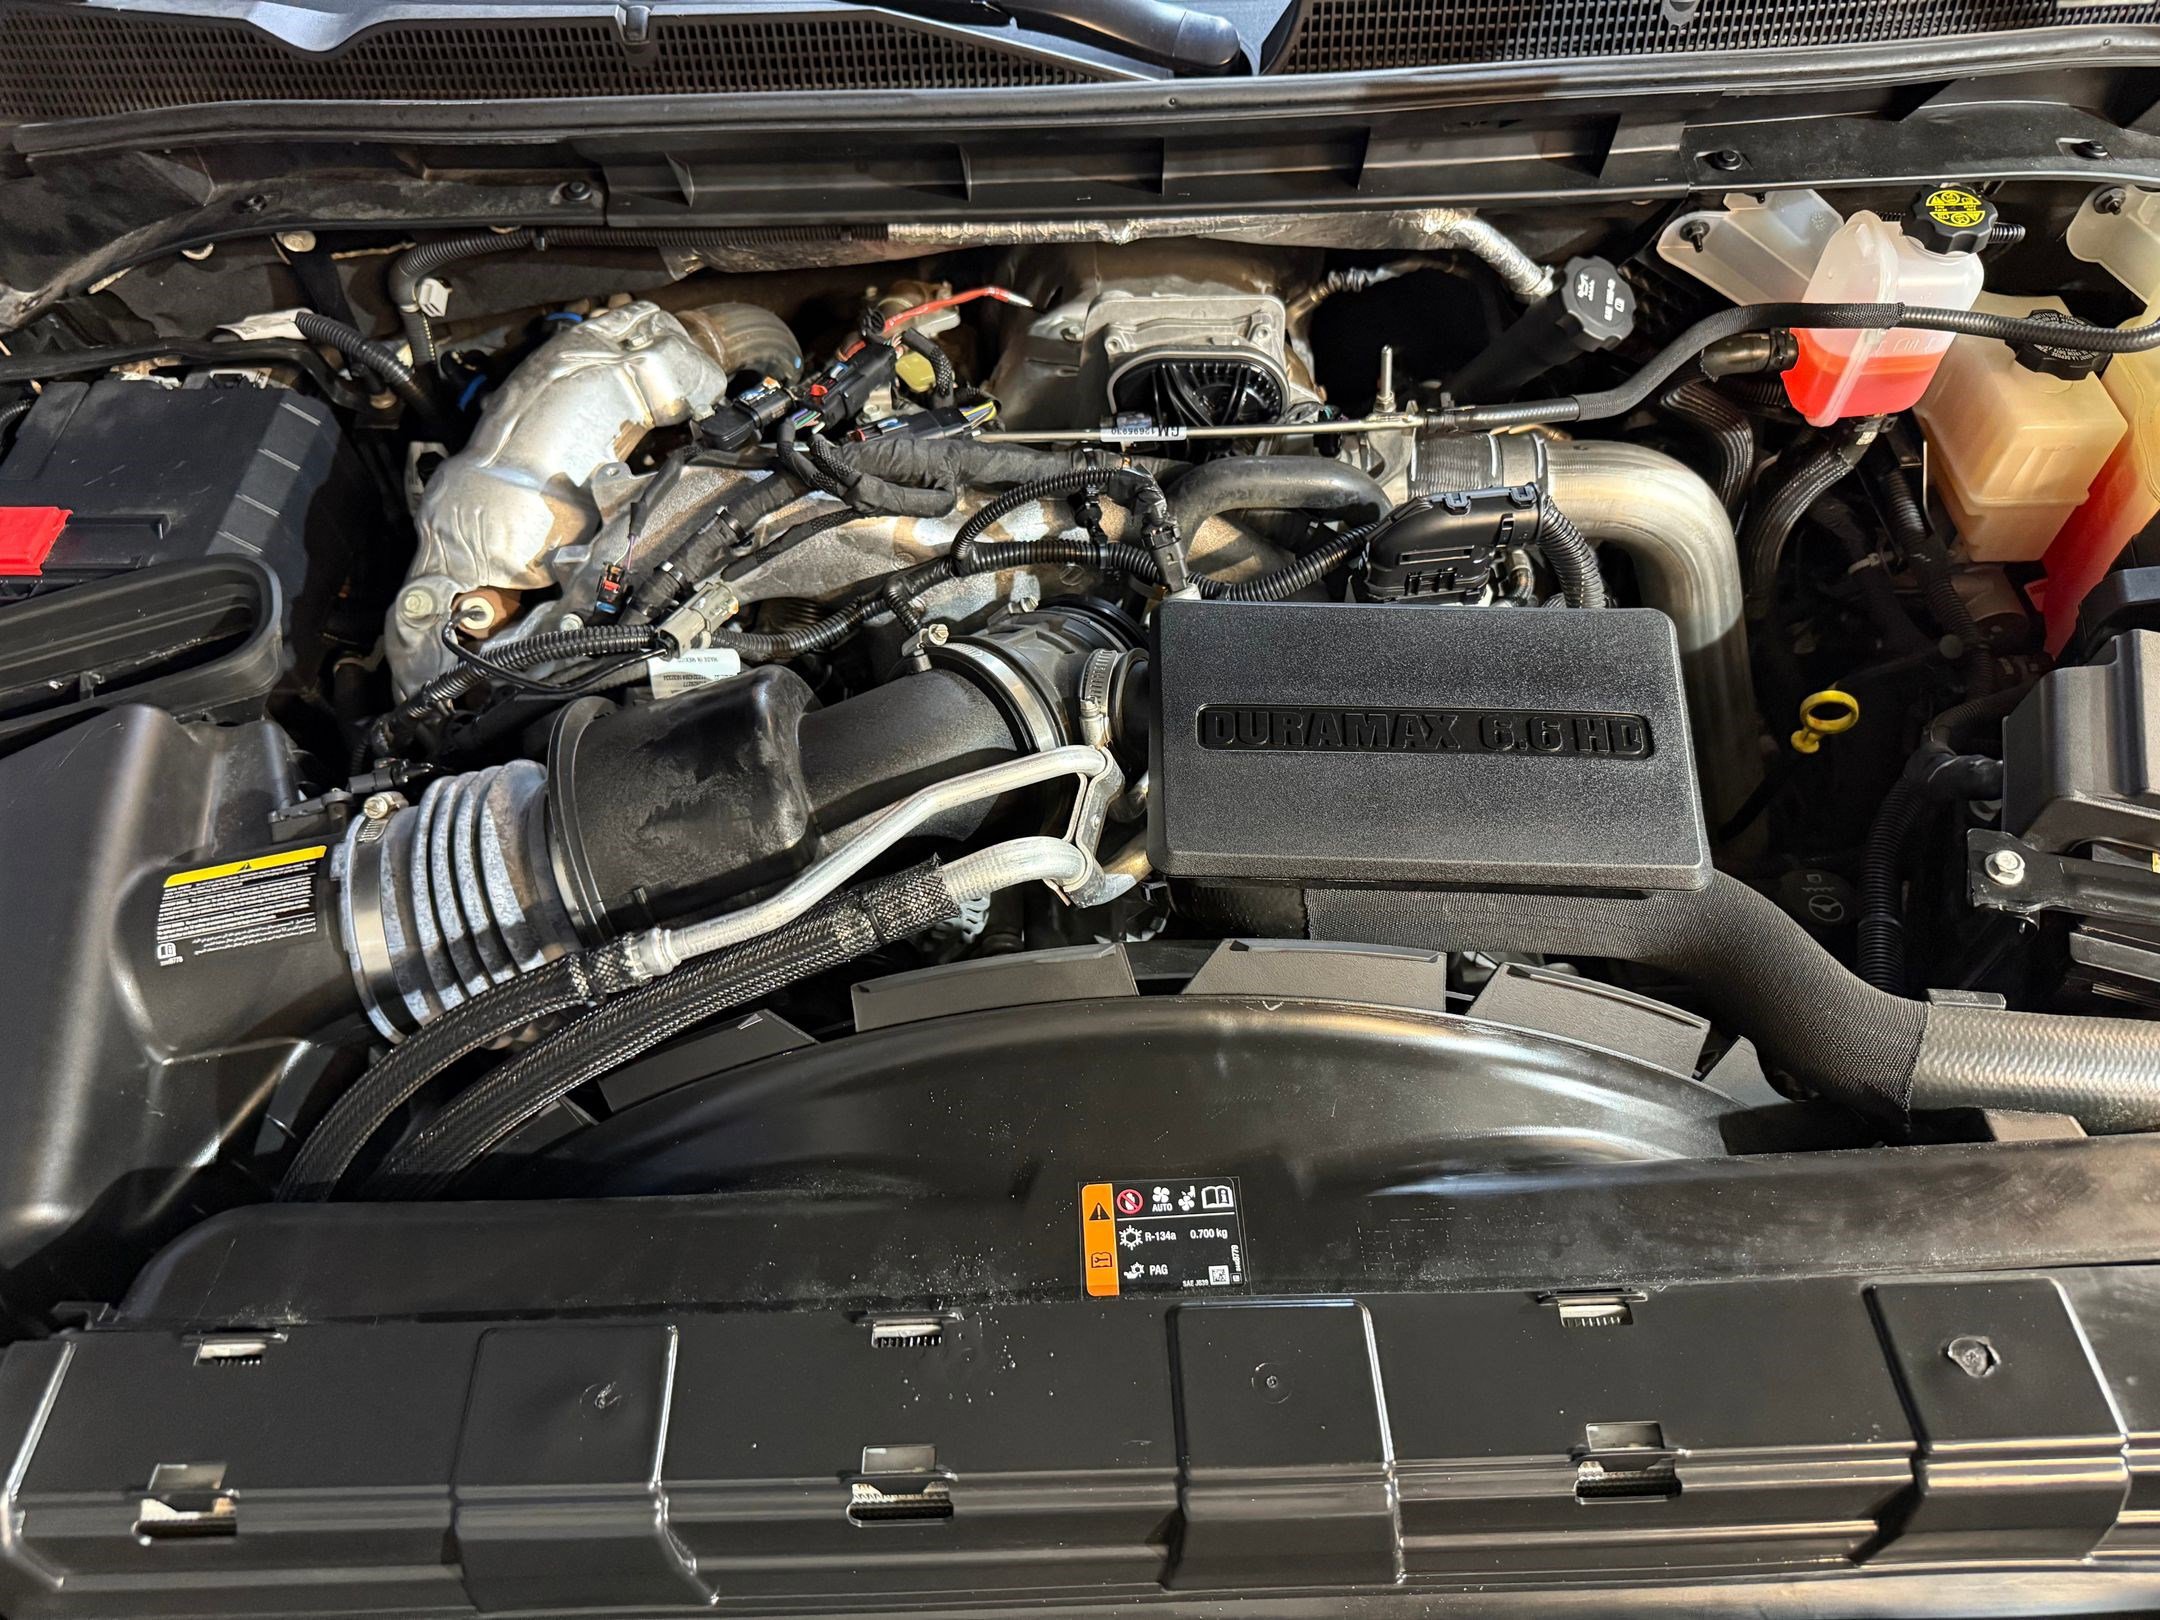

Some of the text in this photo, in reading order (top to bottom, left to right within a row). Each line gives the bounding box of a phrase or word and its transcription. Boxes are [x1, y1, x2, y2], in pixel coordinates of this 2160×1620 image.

[1158, 426, 1179, 437] GM
[1204, 710, 1645, 755] DURAMAX 6.6 HD
[1152, 1203, 1173, 1212] AUTO
[1144, 1227, 1228, 1242] R-134a 0.700 kg
[1149, 1264, 1169, 1276] PAG
